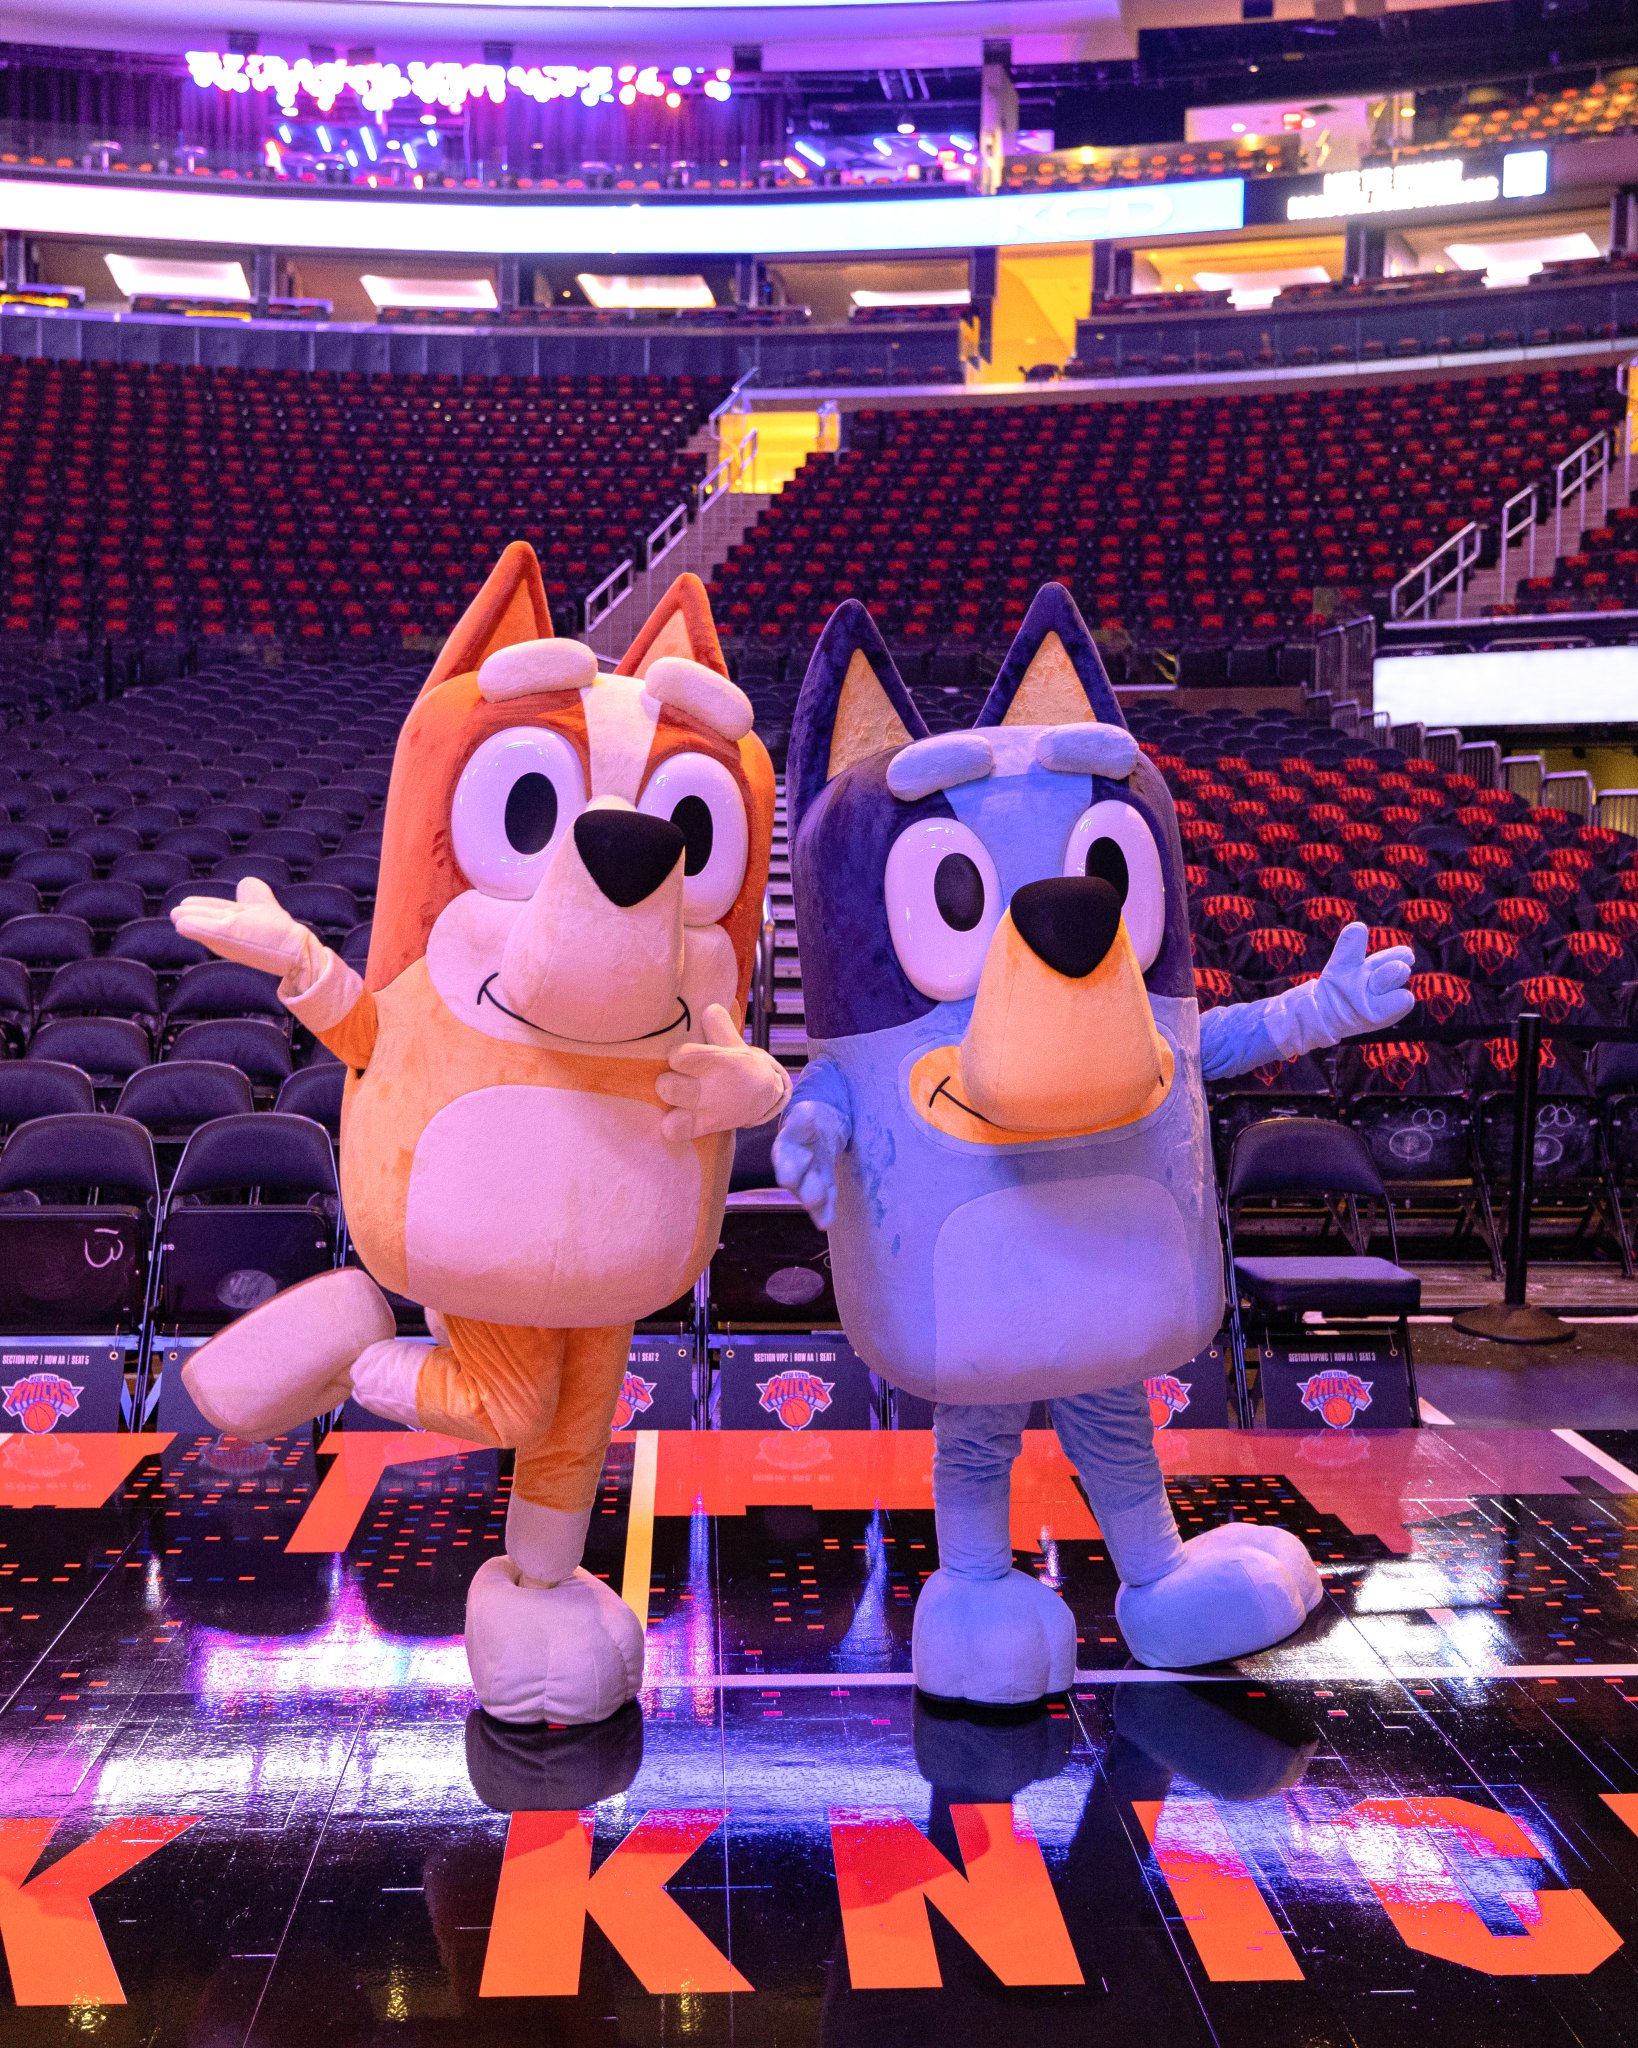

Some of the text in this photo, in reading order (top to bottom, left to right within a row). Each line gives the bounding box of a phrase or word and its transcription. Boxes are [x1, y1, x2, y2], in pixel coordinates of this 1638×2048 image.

[2, 1354, 25, 1365] SECTION
[26, 1354, 38, 1365] VIP2
[44, 1354, 57, 1365] ROW
[57, 1354, 65, 1365] AA
[71, 1354, 85, 1365] SEAT
[642, 1352, 655, 1361] SEAT
[754, 1353, 775, 1362] SECTION
[775, 1353, 788, 1362] VIP2
[794, 1353, 807, 1362] ROW
[806, 1353, 814, 1362] AA
[820, 1353, 832, 1362] SEAT
[1288, 1352, 1309, 1362] SECTION
[6, 1379, 76, 1408] KNICKS
[762, 1378, 830, 1403] KNICKS
[1305, 1377, 1369, 1402] KNICKS
